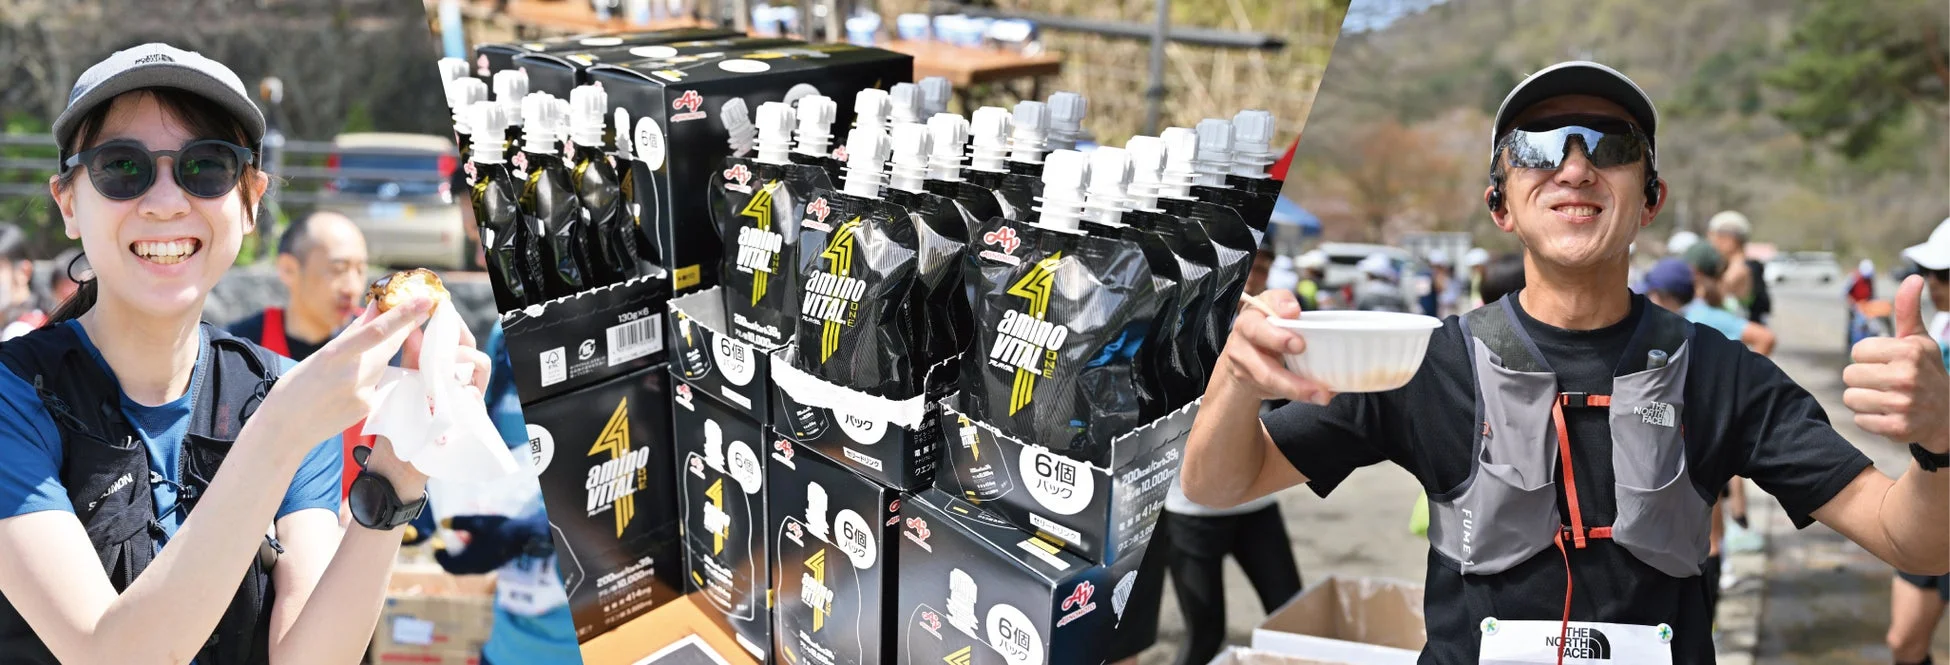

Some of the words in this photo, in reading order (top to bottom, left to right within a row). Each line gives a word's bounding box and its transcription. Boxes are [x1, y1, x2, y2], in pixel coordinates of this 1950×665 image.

[738, 226, 782, 253] amino
[737, 245, 772, 273] VITAL
[805, 268, 866, 302] amino
[802, 291, 846, 325] VITAL
[847, 302, 858, 328] ONE
[997, 309, 1068, 351] amino
[721, 338, 744, 363] 6個
[990, 333, 1042, 376] VITAL
[1043, 350, 1057, 379] ONE
[1634, 406, 1664, 419] NORTH
[1651, 401, 1667, 410] THE
[1642, 415, 1662, 426] FACE
[585, 446, 650, 490] amino
[1035, 453, 1076, 487] 6個
[586, 472, 637, 512] VITAL
[844, 521, 867, 549] 6個
[1462, 508, 1472, 554] FUME
[999, 617, 1030, 652] 6個
[1545, 636, 1588, 648] NORTH
[1566, 627, 1588, 637] THE
[1558, 647, 1588, 659] ACE
